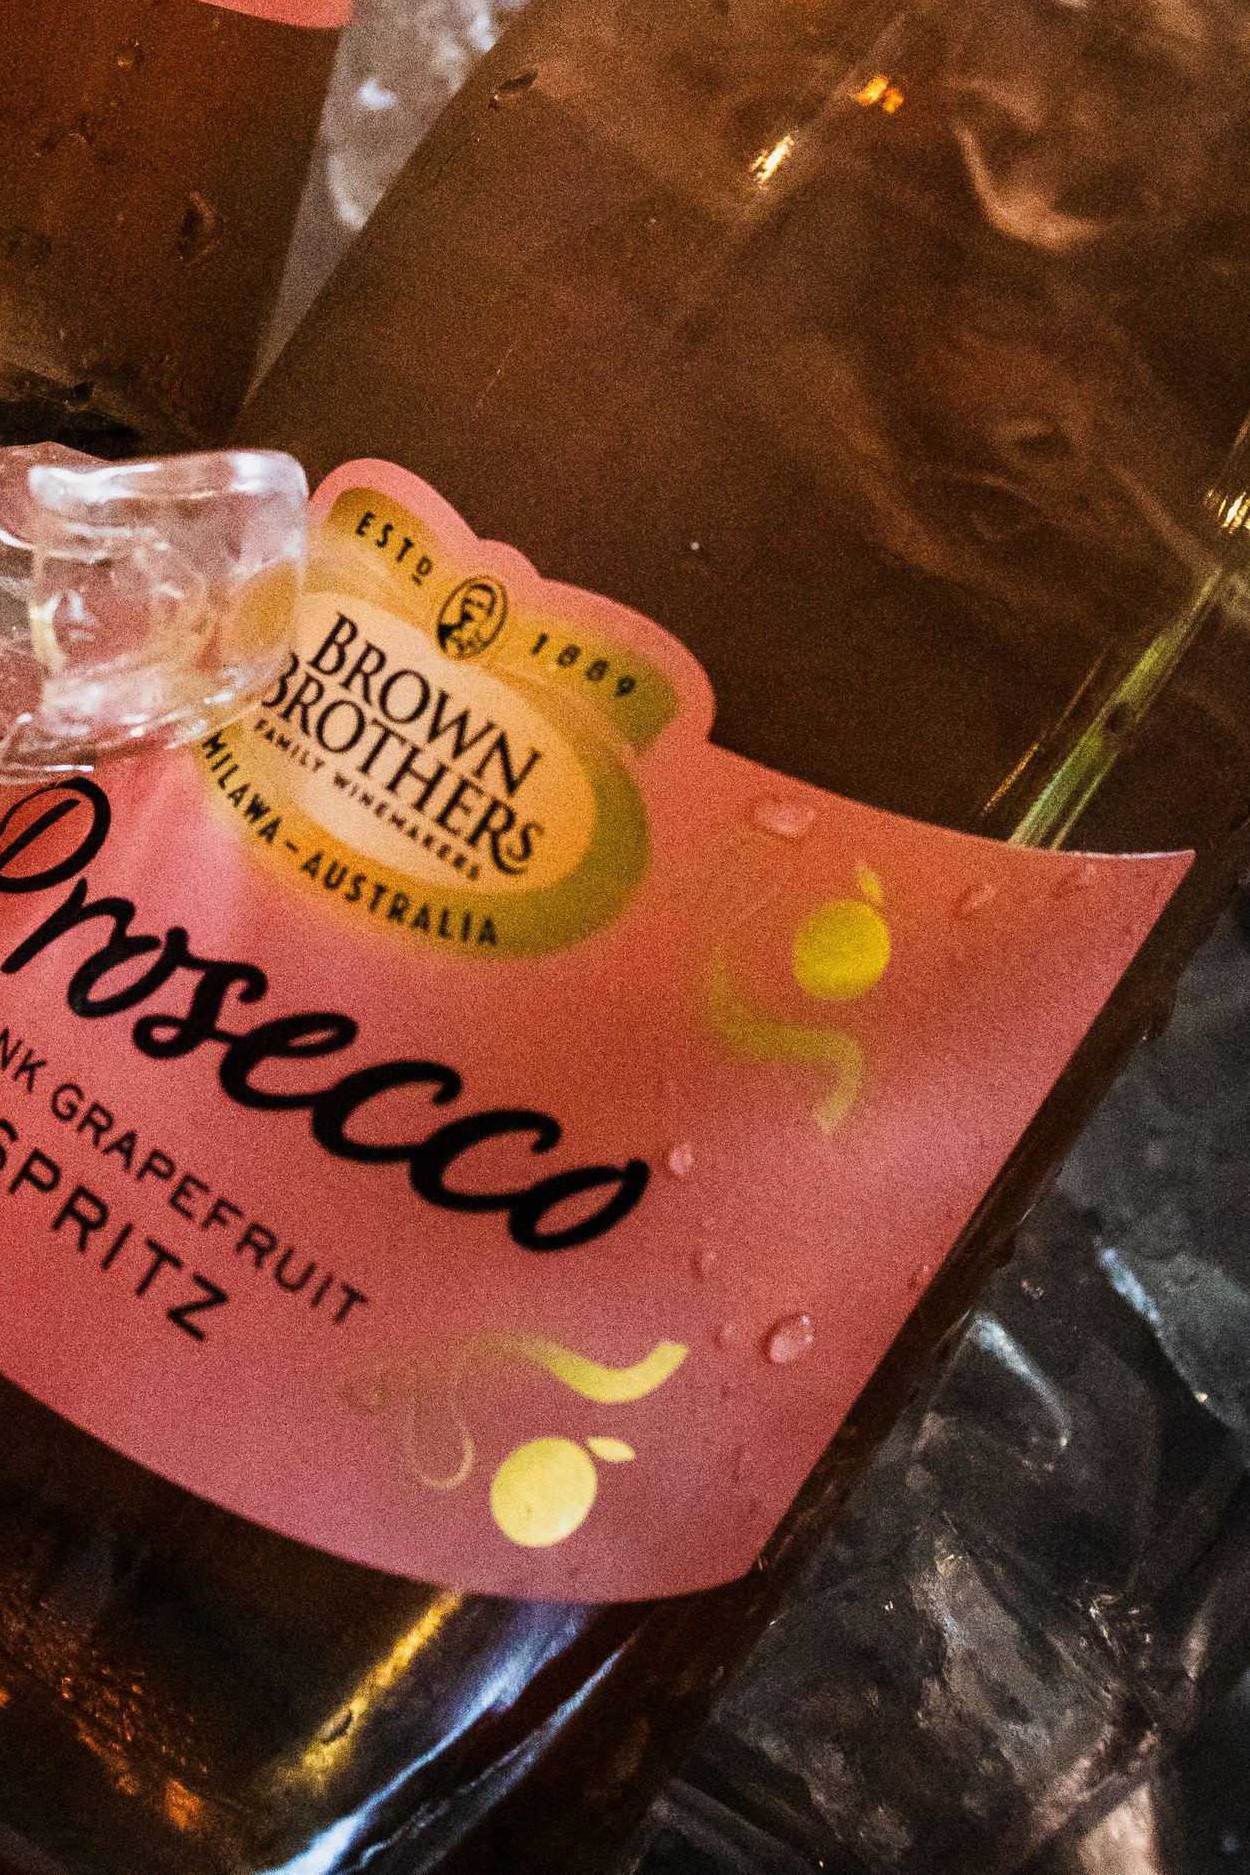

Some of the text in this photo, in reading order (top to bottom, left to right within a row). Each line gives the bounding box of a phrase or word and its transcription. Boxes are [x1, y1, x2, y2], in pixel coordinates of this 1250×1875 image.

[306, 611, 543, 798] BROWN
[530, 632, 637, 699] 1889
[254, 718, 483, 882] FAMILY WINEMAKERS
[50, 1082, 369, 1326] GRAPEFRUIT
